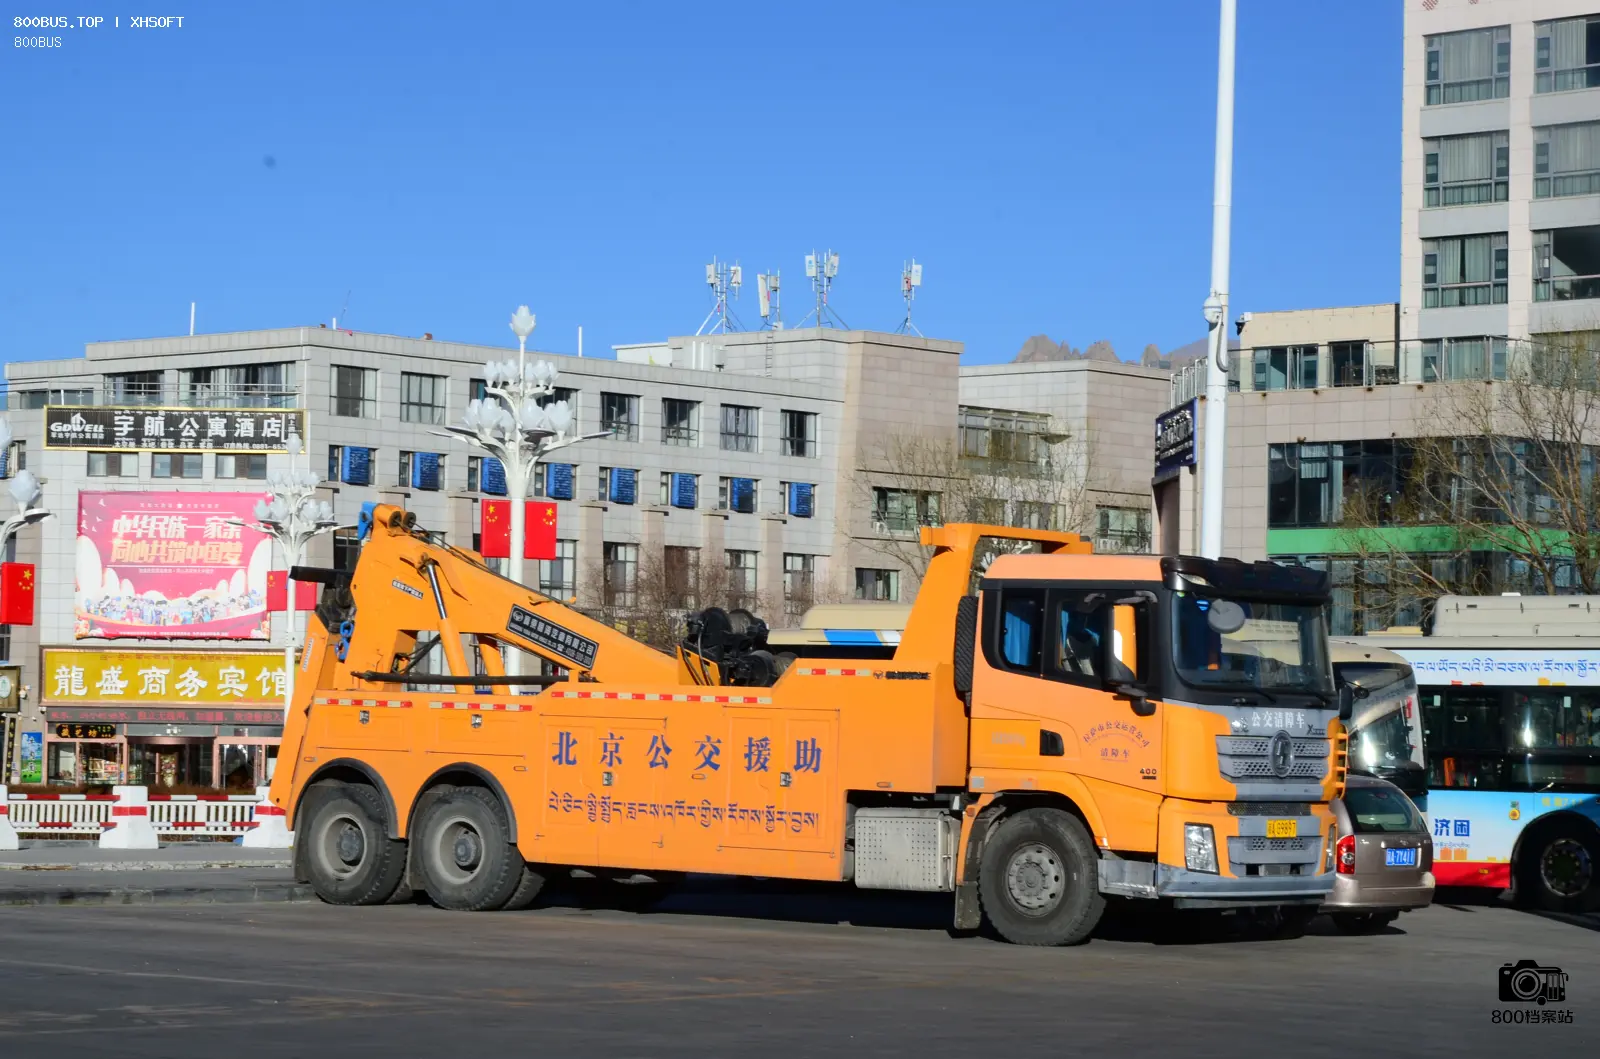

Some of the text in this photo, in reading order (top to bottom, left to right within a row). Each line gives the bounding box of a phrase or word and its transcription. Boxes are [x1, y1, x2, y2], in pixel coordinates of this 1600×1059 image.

[112, 515, 244, 539] 中华民族一家亲
[111, 540, 243, 564] 同心共筑中国梦
[54, 665, 286, 698] 龍盛商务宾馆
[1251, 711, 1305, 729] 公交清障车
[552, 731, 823, 774] 北京公交援助
[1434, 818, 1471, 837] 济困
